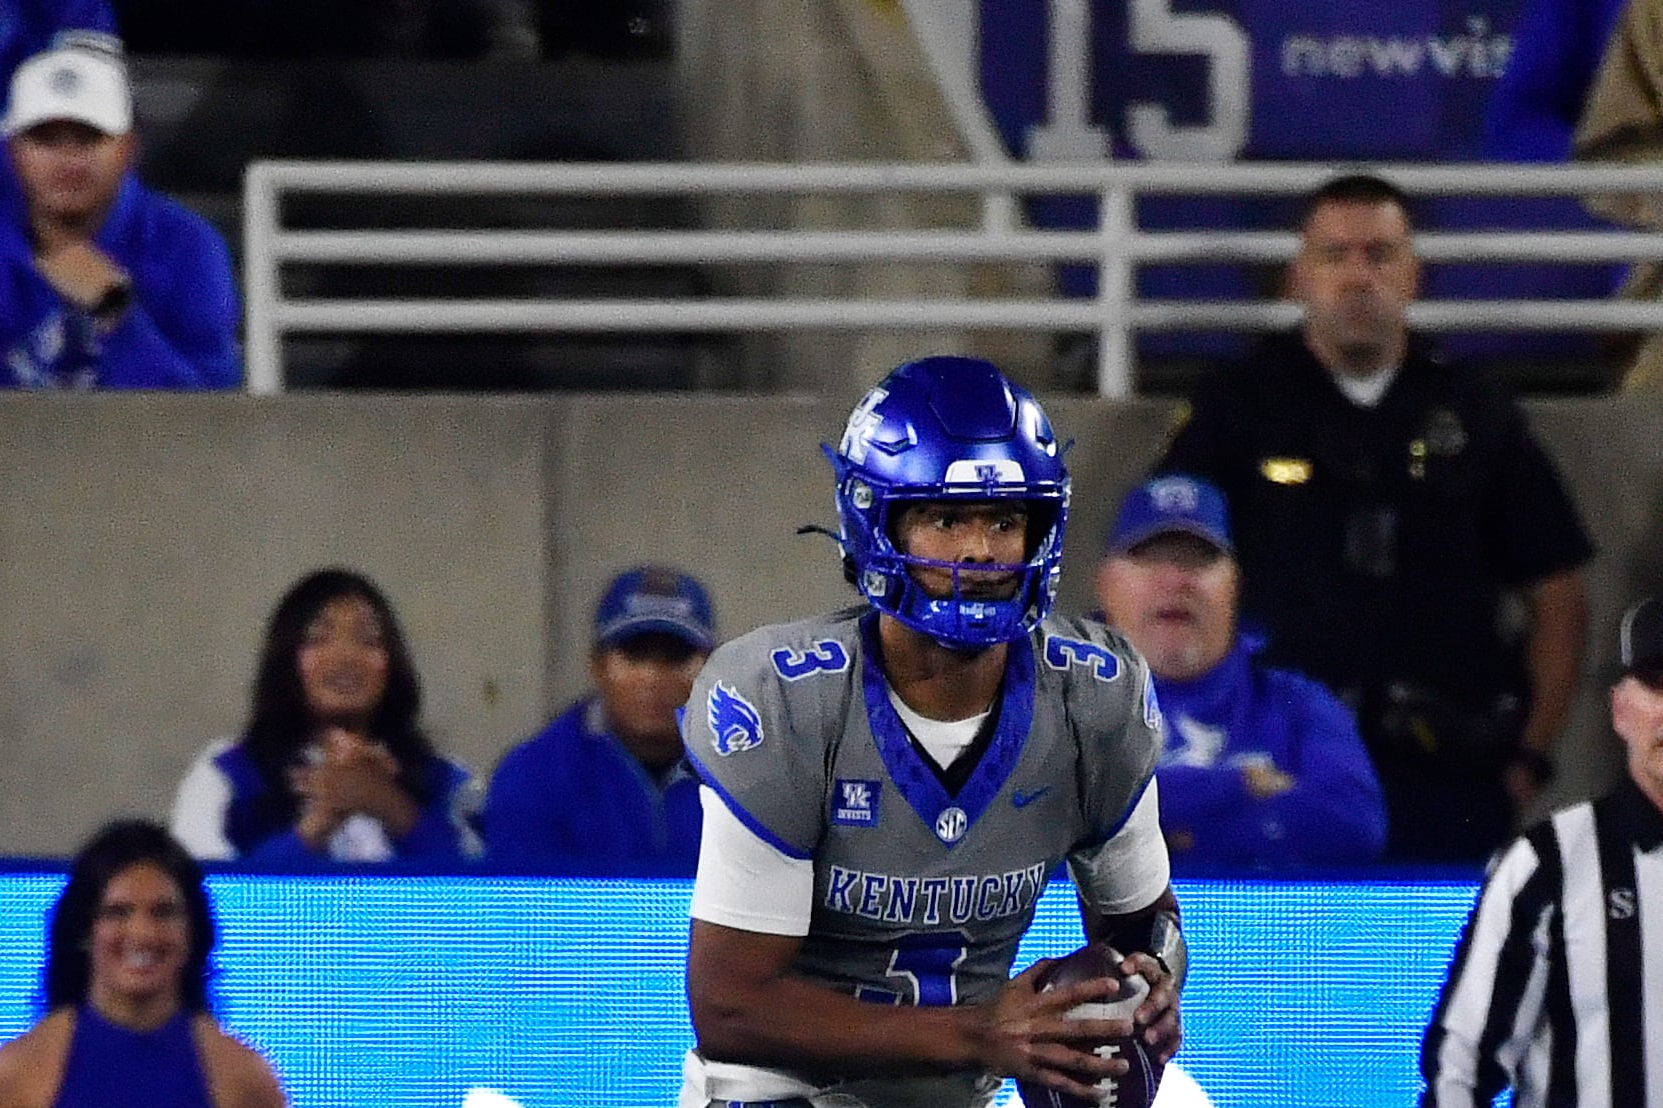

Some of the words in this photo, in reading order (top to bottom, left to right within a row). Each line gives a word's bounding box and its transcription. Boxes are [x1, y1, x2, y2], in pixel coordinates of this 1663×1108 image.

[1025, 0, 1251, 163] 15
[771, 638, 851, 682] 3
[1044, 633, 1120, 683] 3
[825, 861, 1045, 925] KENTUCKY
[1610, 888, 1635, 919] S
